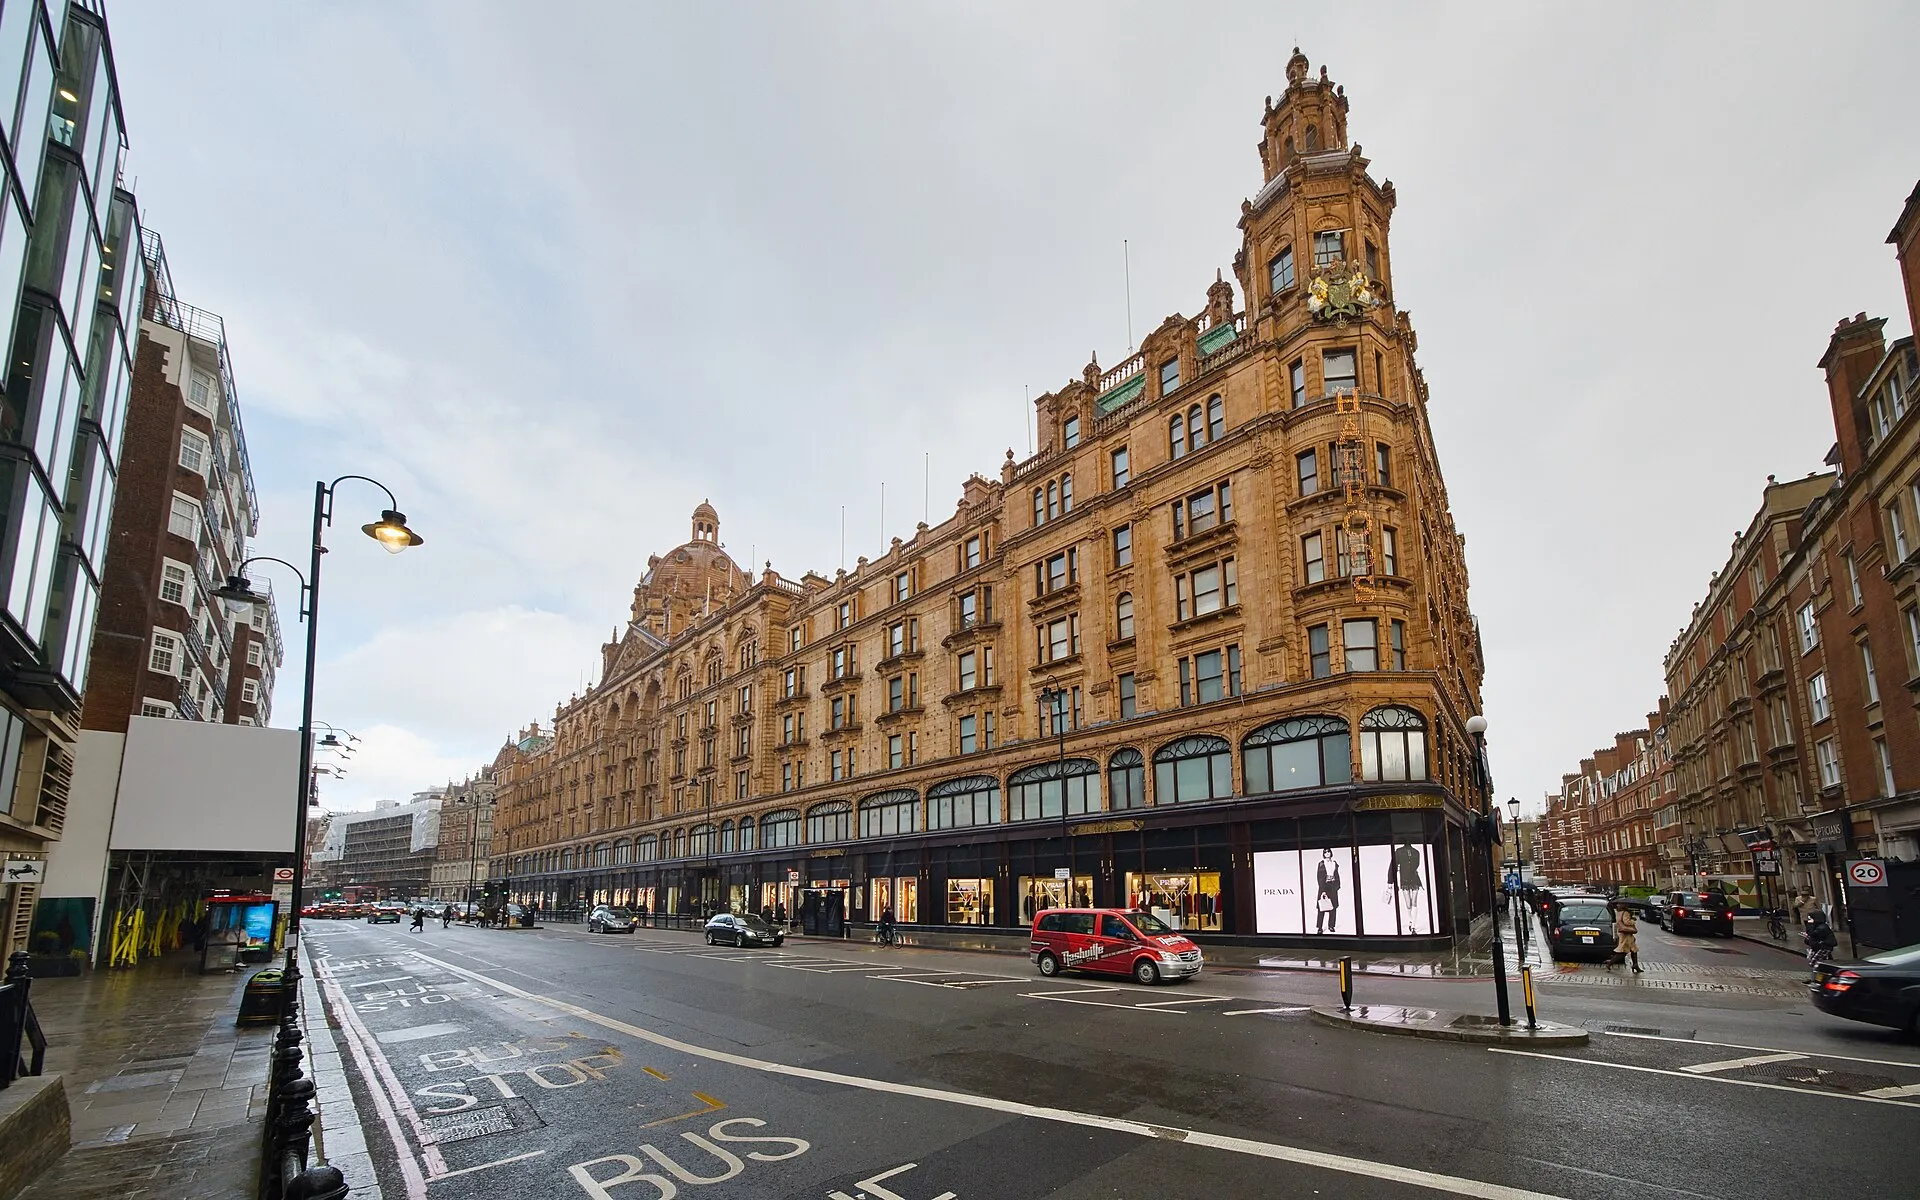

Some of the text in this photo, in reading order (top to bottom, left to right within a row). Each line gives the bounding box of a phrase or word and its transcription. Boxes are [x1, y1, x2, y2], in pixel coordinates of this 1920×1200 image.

[1335, 387, 1376, 603] HARRODS
[1815, 824, 1841, 836] OPTICIANS
[1855, 868, 1879, 878] 20
[1263, 888, 1294, 896] PRADA
[1061, 943, 1104, 967] Nashville
[418, 1041, 569, 1073] BUS
[414, 1046, 624, 1113] STOP
[567, 1117, 811, 1200] BUS
